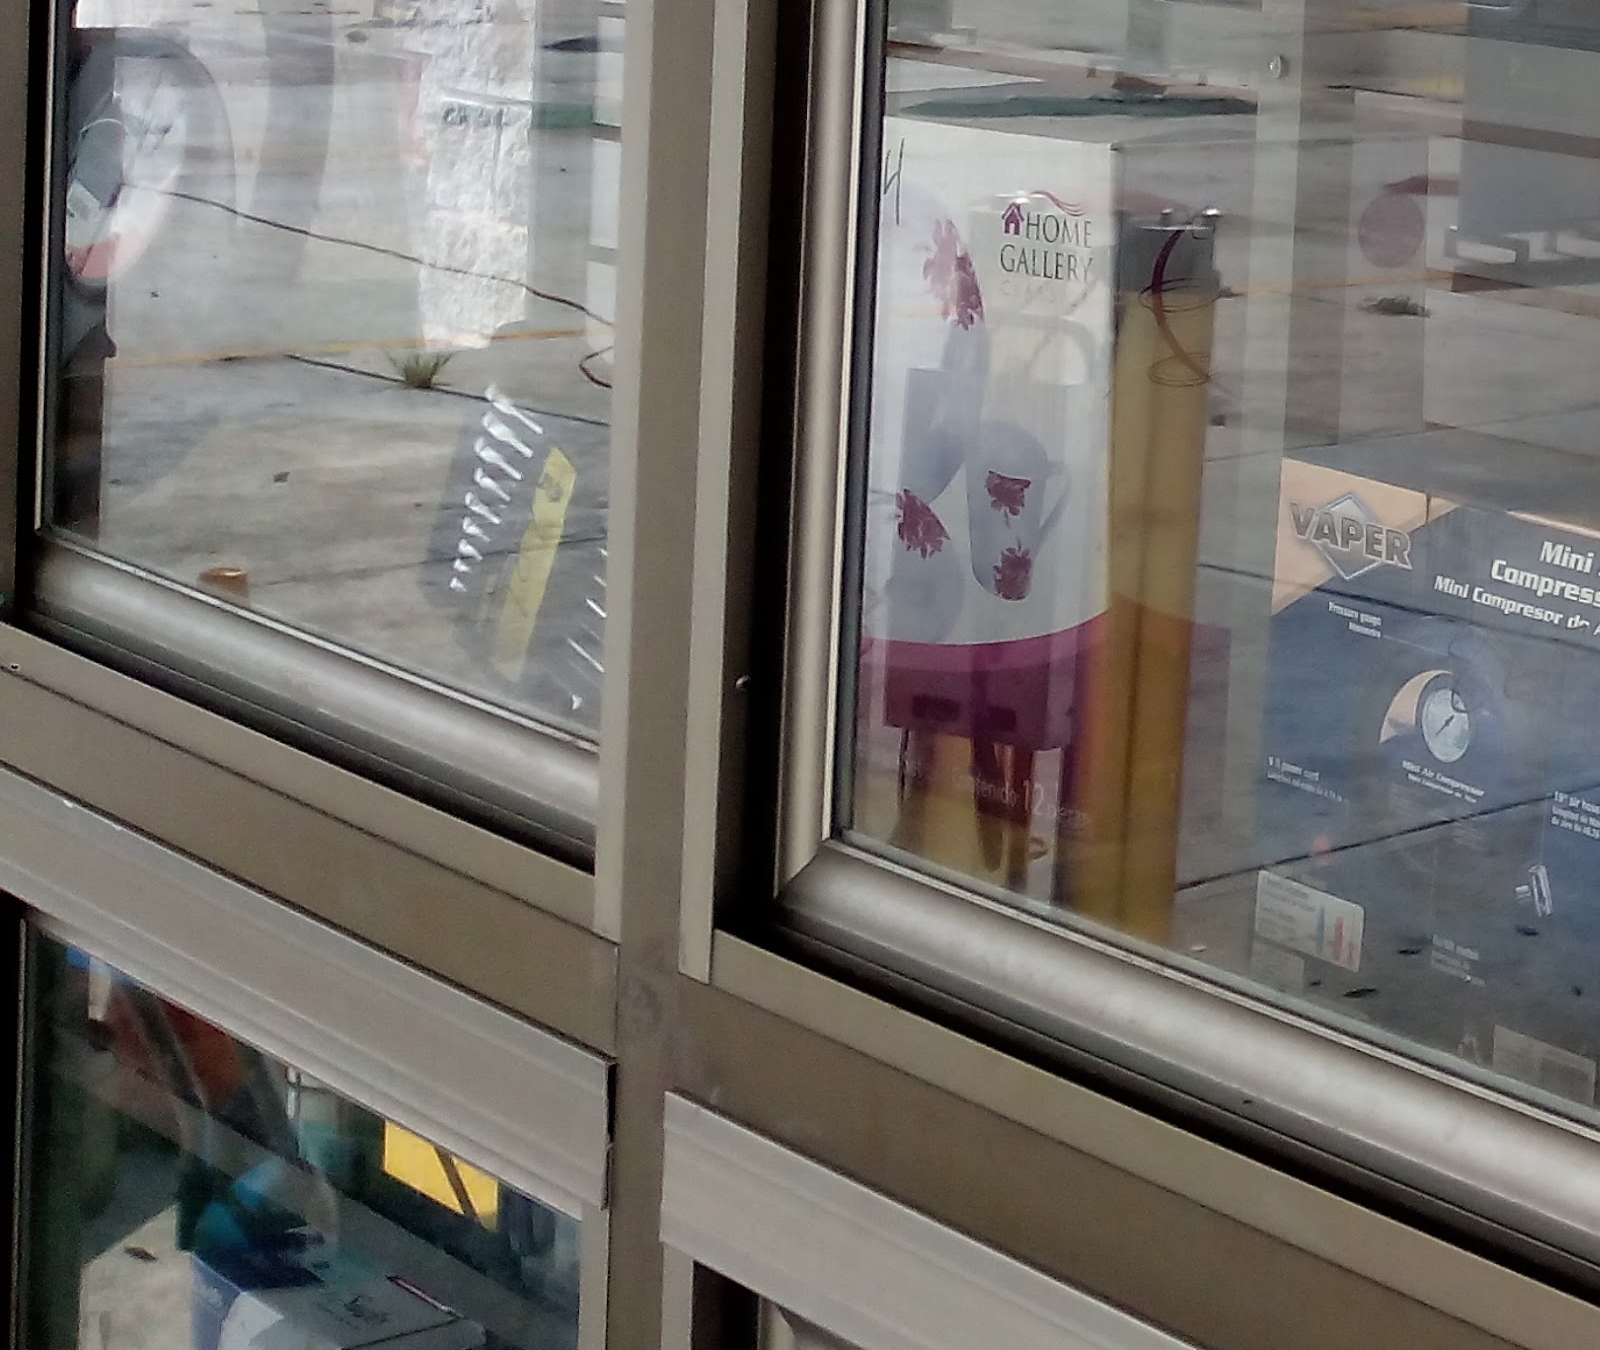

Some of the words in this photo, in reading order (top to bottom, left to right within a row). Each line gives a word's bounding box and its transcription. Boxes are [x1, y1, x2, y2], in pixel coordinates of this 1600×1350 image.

[1026, 212, 1092, 249] HOME
[1000, 244, 1093, 283] GALLERY
[1290, 502, 1413, 570] VAPER
[1539, 540, 1594, 575] Mini
[1434, 575, 1468, 600] Mini
[1471, 586, 1564, 626] Compresor
